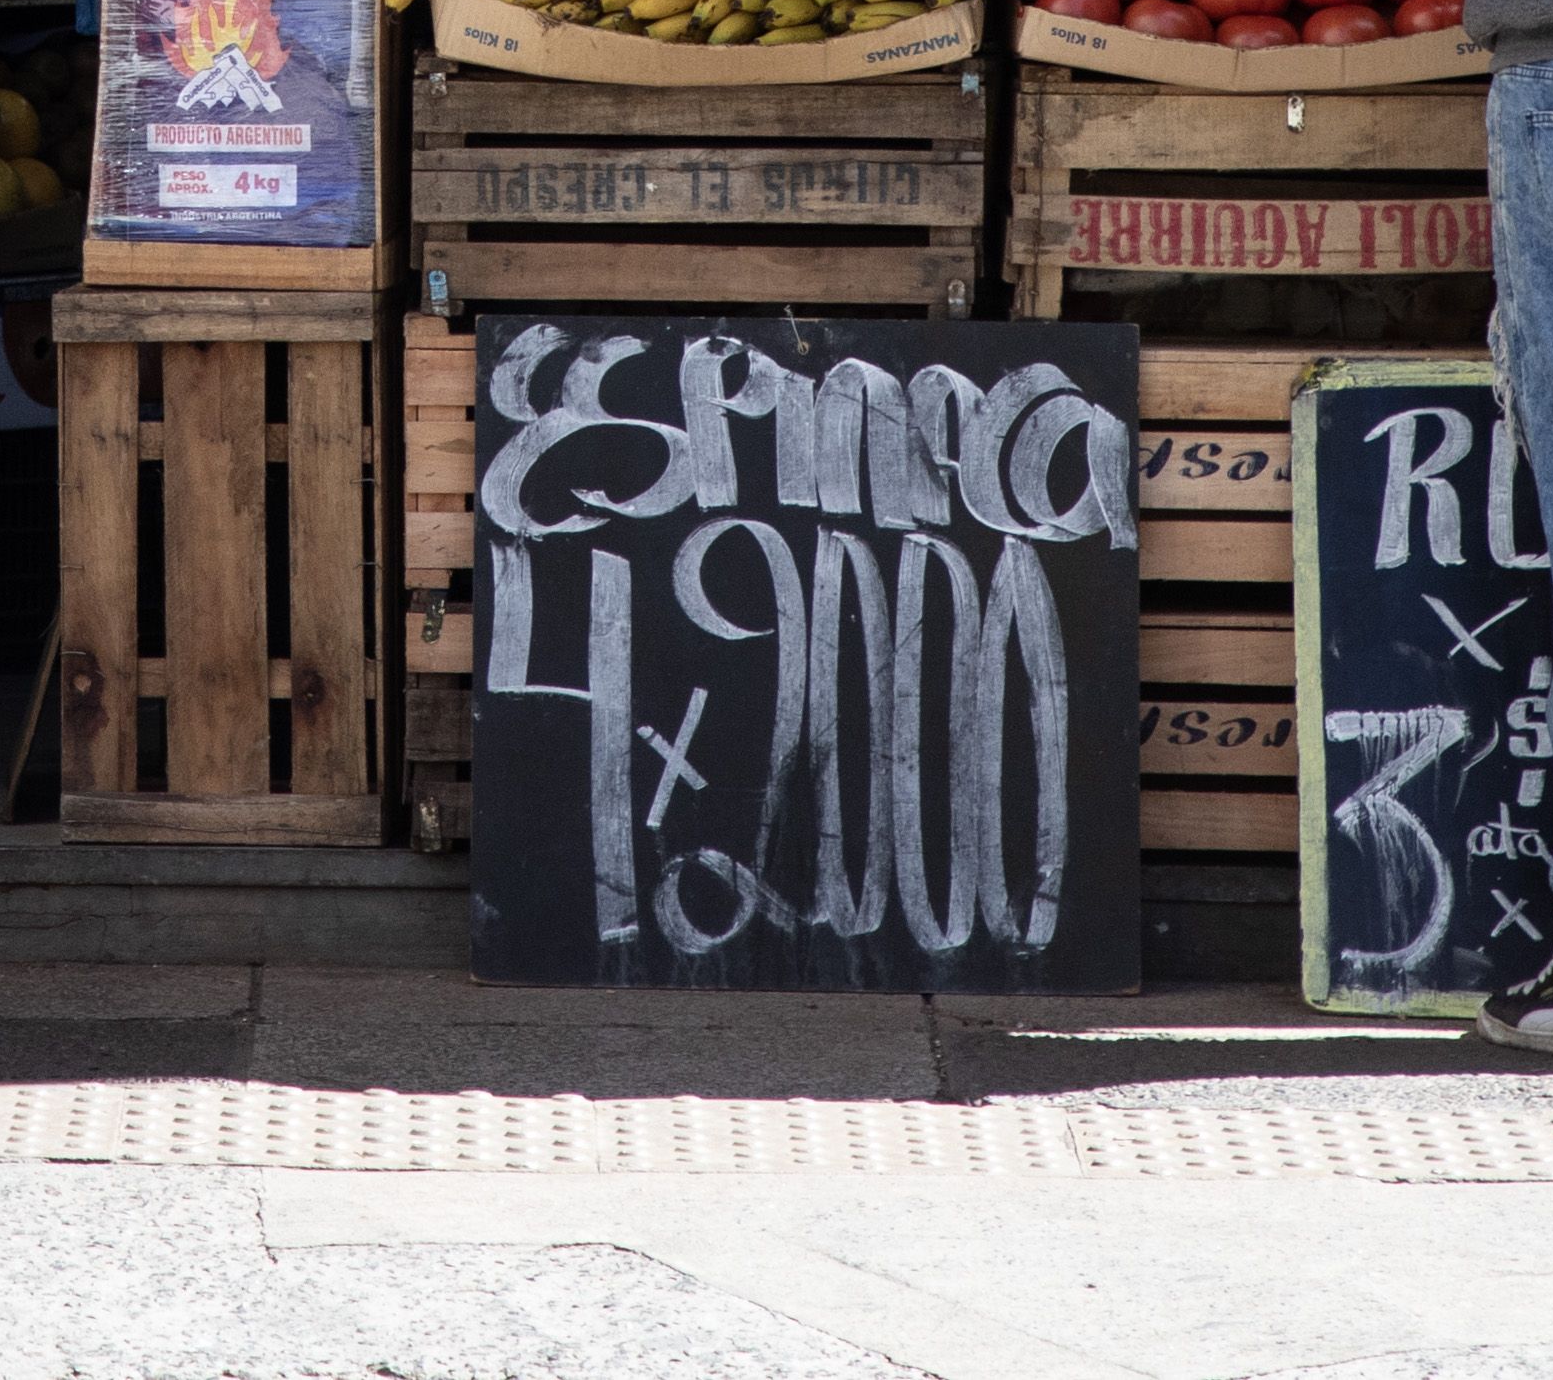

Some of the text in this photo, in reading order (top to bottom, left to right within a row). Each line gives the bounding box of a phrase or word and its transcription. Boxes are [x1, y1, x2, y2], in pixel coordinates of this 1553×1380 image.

[462, 26, 520, 53] 18 Kilos
[866, 31, 962, 63] MANZANAS
[1050, 25, 1107, 51] 18 Kilos
[245, 68, 271, 99] Blanco
[153, 124, 304, 147] PRODUCTO ARGENTINO
[234, 172, 280, 196] 4 kg
[225, 211, 283, 221] ARGENTINA
[1069, 198, 1330, 271] AGUIRRE
